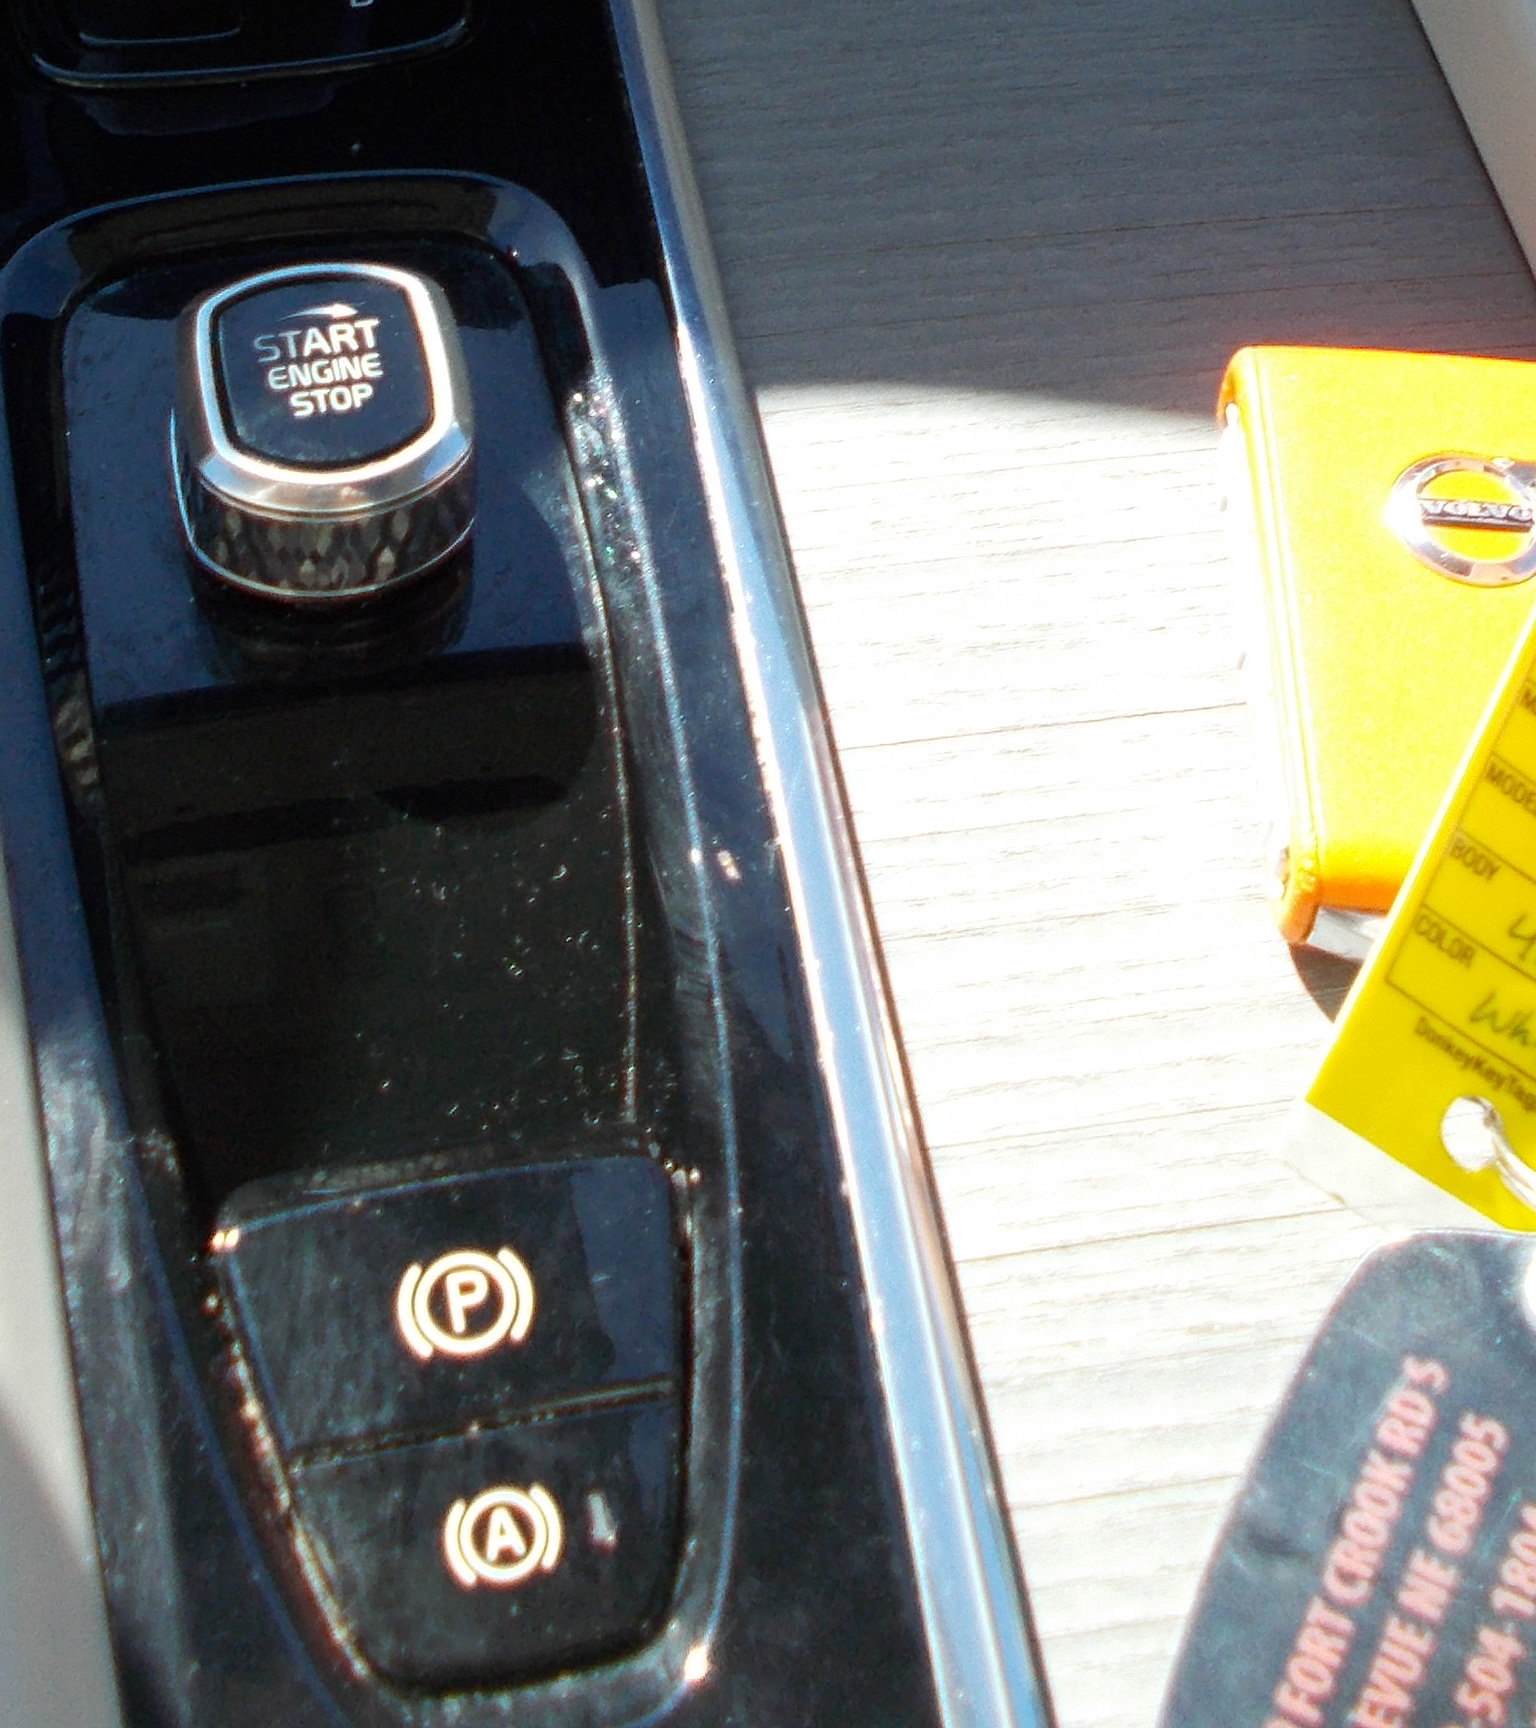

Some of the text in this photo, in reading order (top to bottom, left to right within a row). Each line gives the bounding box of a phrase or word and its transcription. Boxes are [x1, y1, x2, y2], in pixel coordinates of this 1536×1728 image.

[253, 317, 381, 363] START
[267, 352, 384, 390] ENGINE
[289, 383, 374, 418] STOP
[1449, 840, 1502, 883] BODY
[1414, 913, 1476, 968] COLOR
[1425, 1411, 1509, 1556] 68005
[1274, 1594, 1357, 1724] FORT
[1321, 1448, 1414, 1607] CROOK
[1376, 1388, 1437, 1459] RD
[1395, 1548, 1460, 1623] NE
